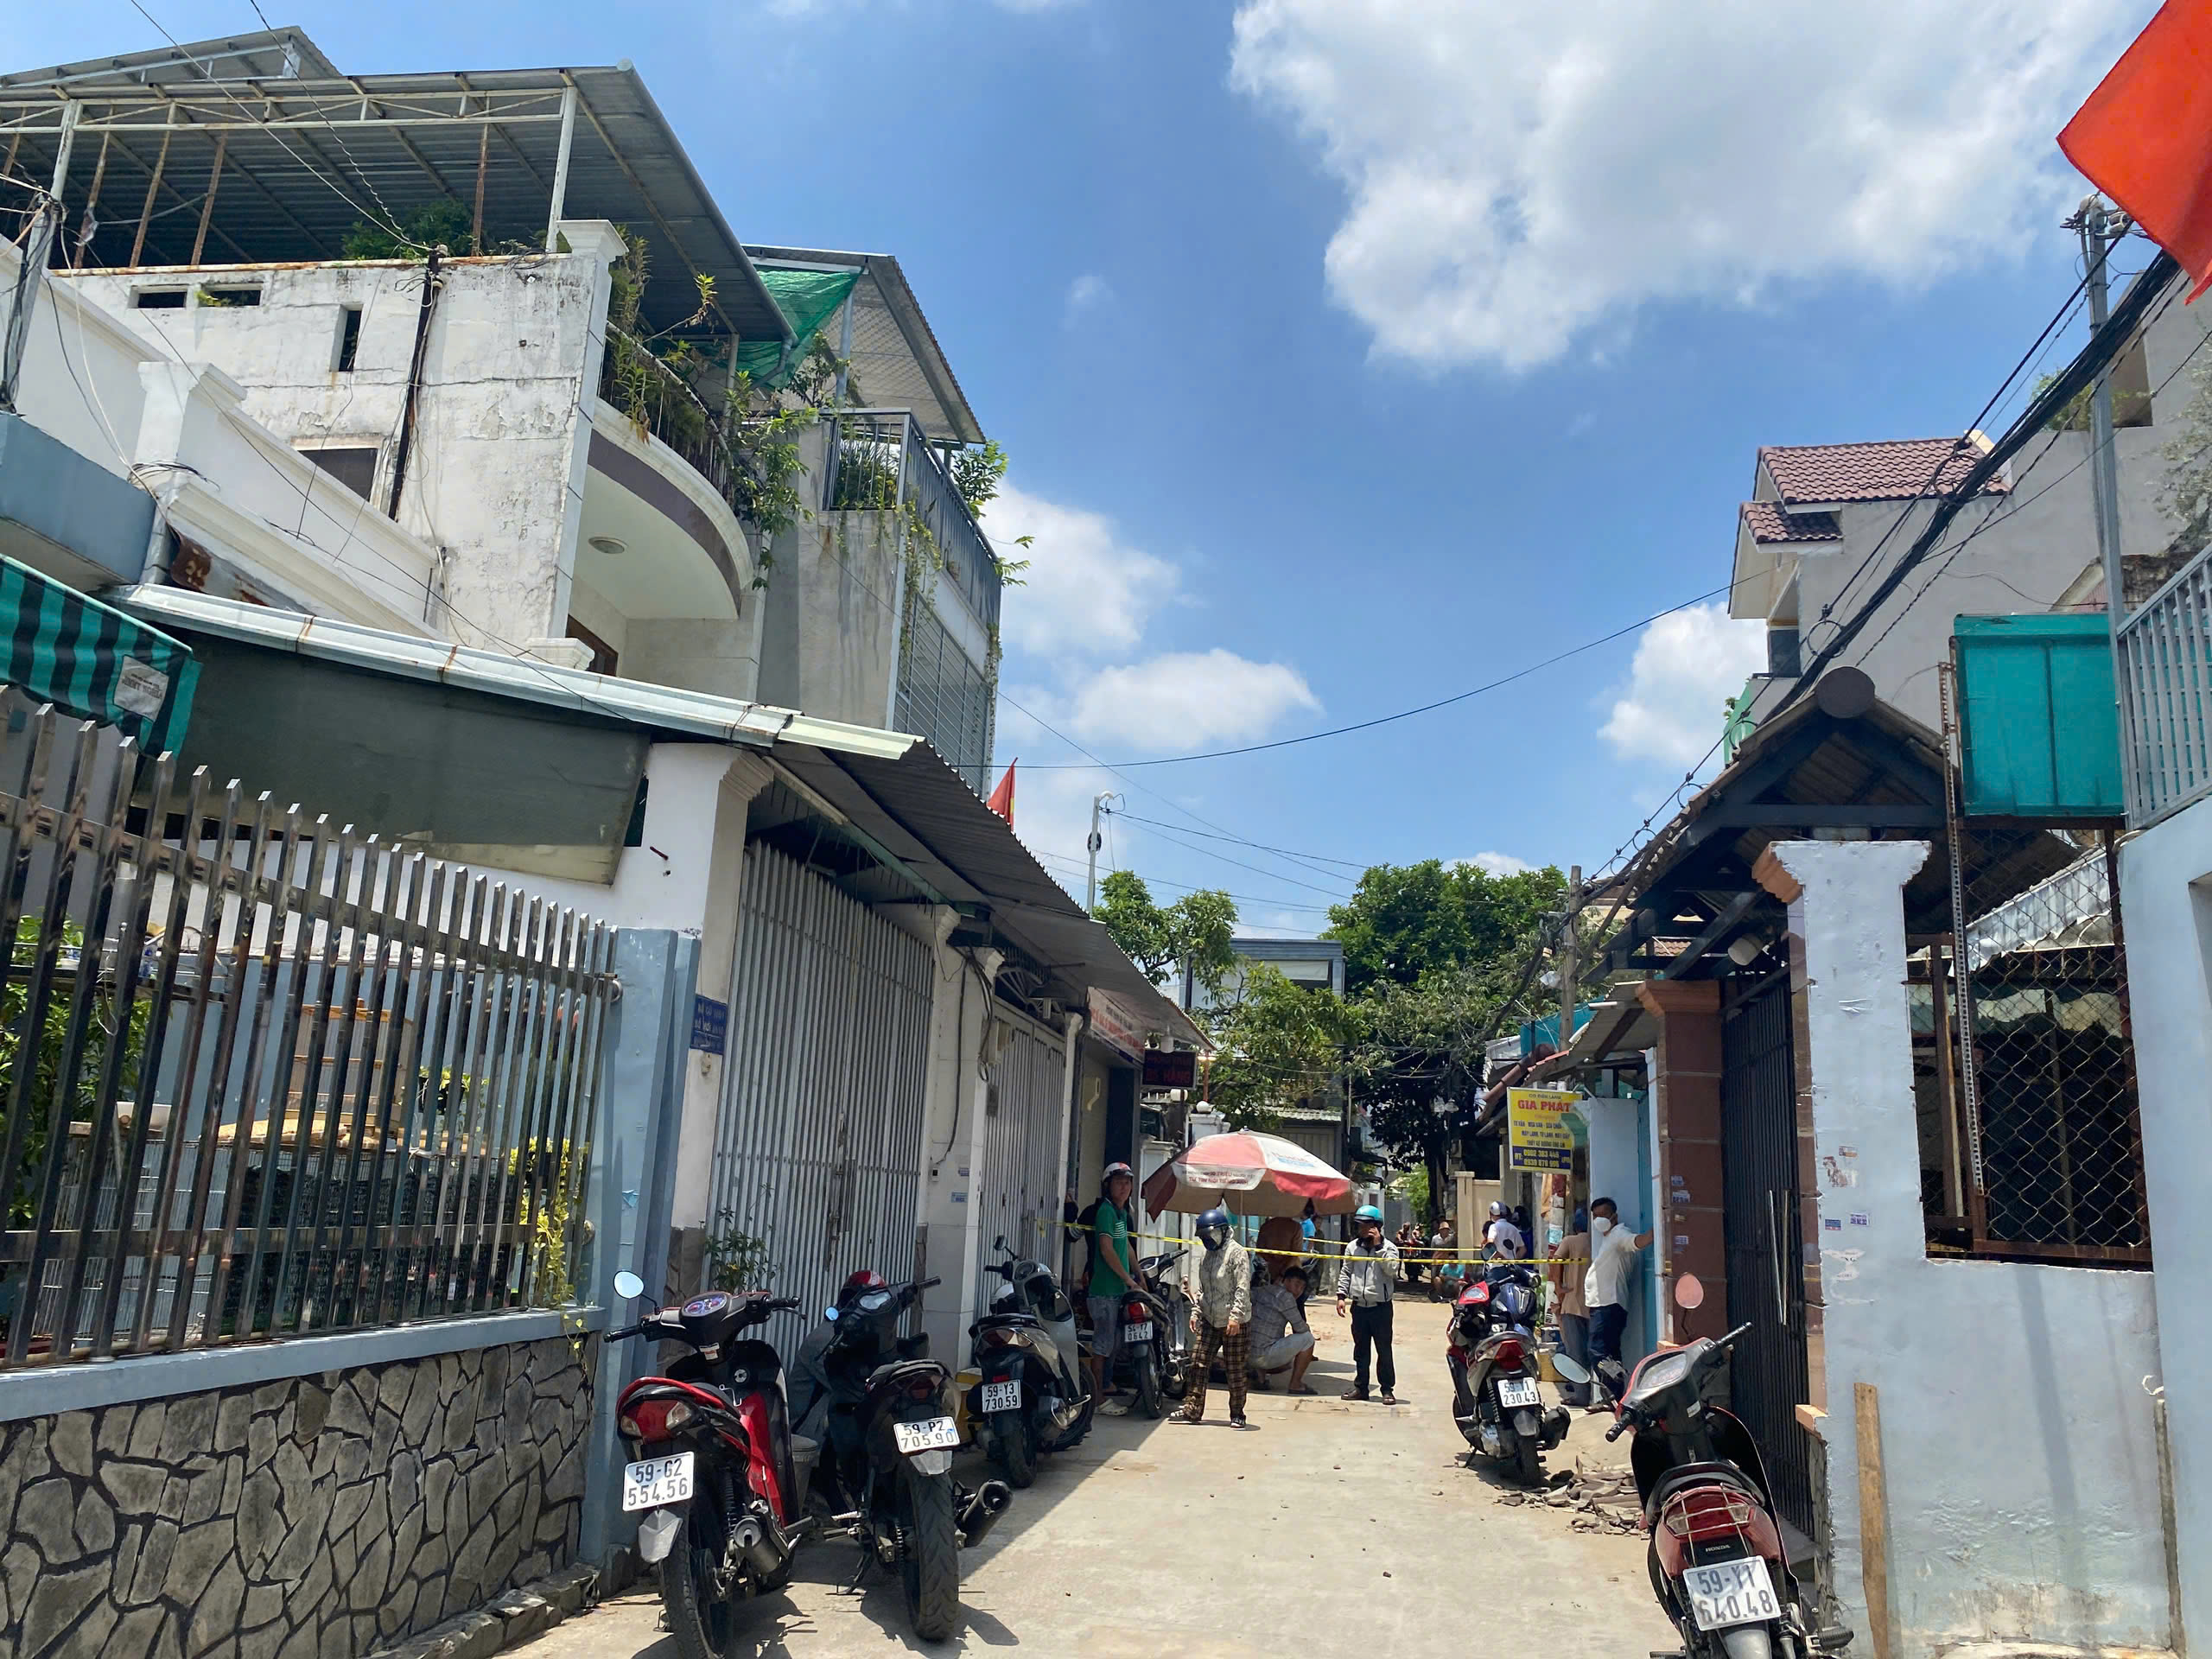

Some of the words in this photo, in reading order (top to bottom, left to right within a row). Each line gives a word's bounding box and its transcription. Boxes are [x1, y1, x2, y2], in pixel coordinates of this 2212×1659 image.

[1518, 1099, 1537, 1110] GIA
[988, 1382, 1014, 1397] 59-Y3
[985, 1395, 1017, 1410] 730.59
[1503, 1391, 1536, 1405] 230.43
[903, 1421, 945, 1435] 59-P2
[900, 1432, 954, 1451] 705.90
[635, 1458, 683, 1484] 59-G2
[628, 1478, 688, 1506] 554.56
[1705, 1544, 1731, 1553] HONDA
[1697, 1564, 1756, 1595] 59-Y1
[1699, 1589, 1774, 1624] 640.48
